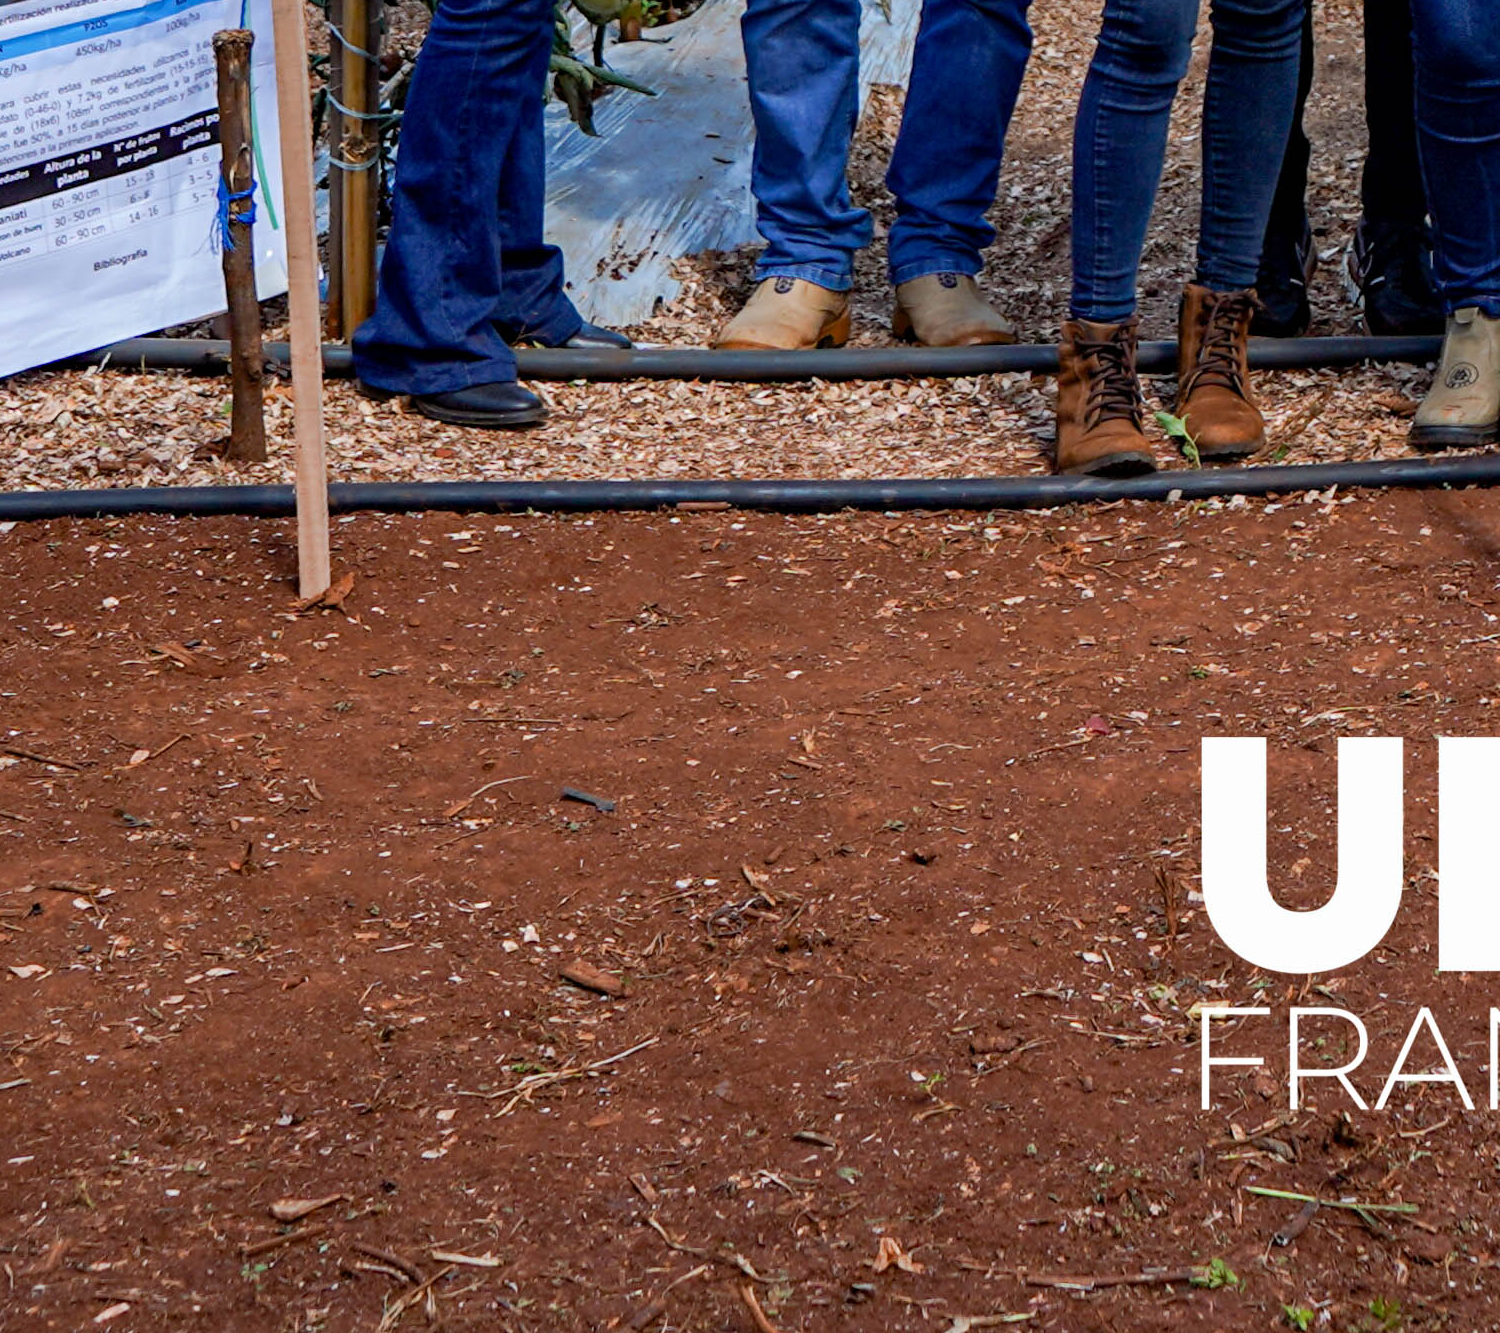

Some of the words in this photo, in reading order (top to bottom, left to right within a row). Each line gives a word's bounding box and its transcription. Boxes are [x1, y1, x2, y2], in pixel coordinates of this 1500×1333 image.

[205, 113, 220, 127] po
[43, 156, 75, 174] Altura
[76, 153, 88, 165] de
[91, 150, 102, 161] la
[56, 169, 90, 188] planta
[87, 190, 100, 200] cm
[88, 207, 101, 217] cm
[91, 223, 106, 234] cm
